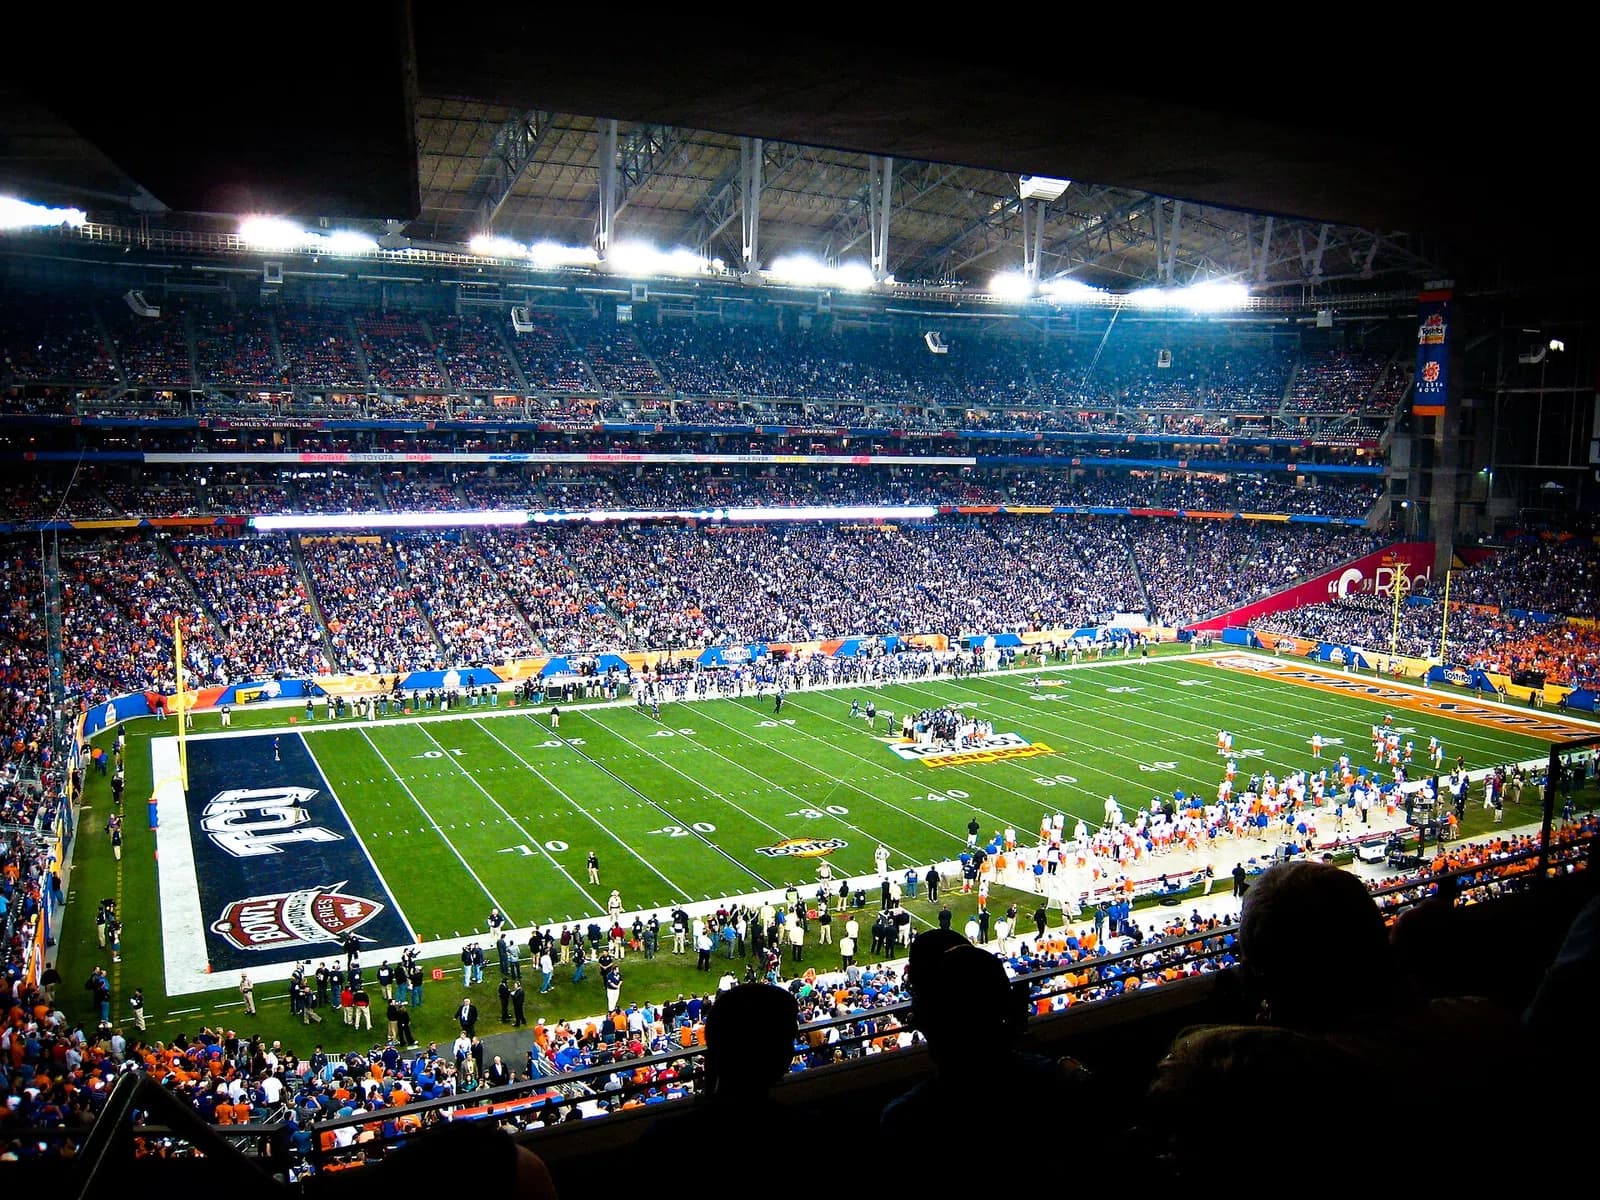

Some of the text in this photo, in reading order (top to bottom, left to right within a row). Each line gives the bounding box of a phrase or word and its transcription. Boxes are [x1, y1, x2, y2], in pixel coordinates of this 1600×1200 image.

[927, 745, 1049, 765] FIESTA BOWL
[1033, 775, 1078, 786] 50
[927, 789, 970, 801] 40
[799, 805, 849, 819] 30
[201, 786, 344, 857] TCU
[661, 822, 716, 837] 20
[318, 897, 345, 929] SERIES
[340, 901, 367, 919] FOX
[239, 899, 288, 943] BOWL
